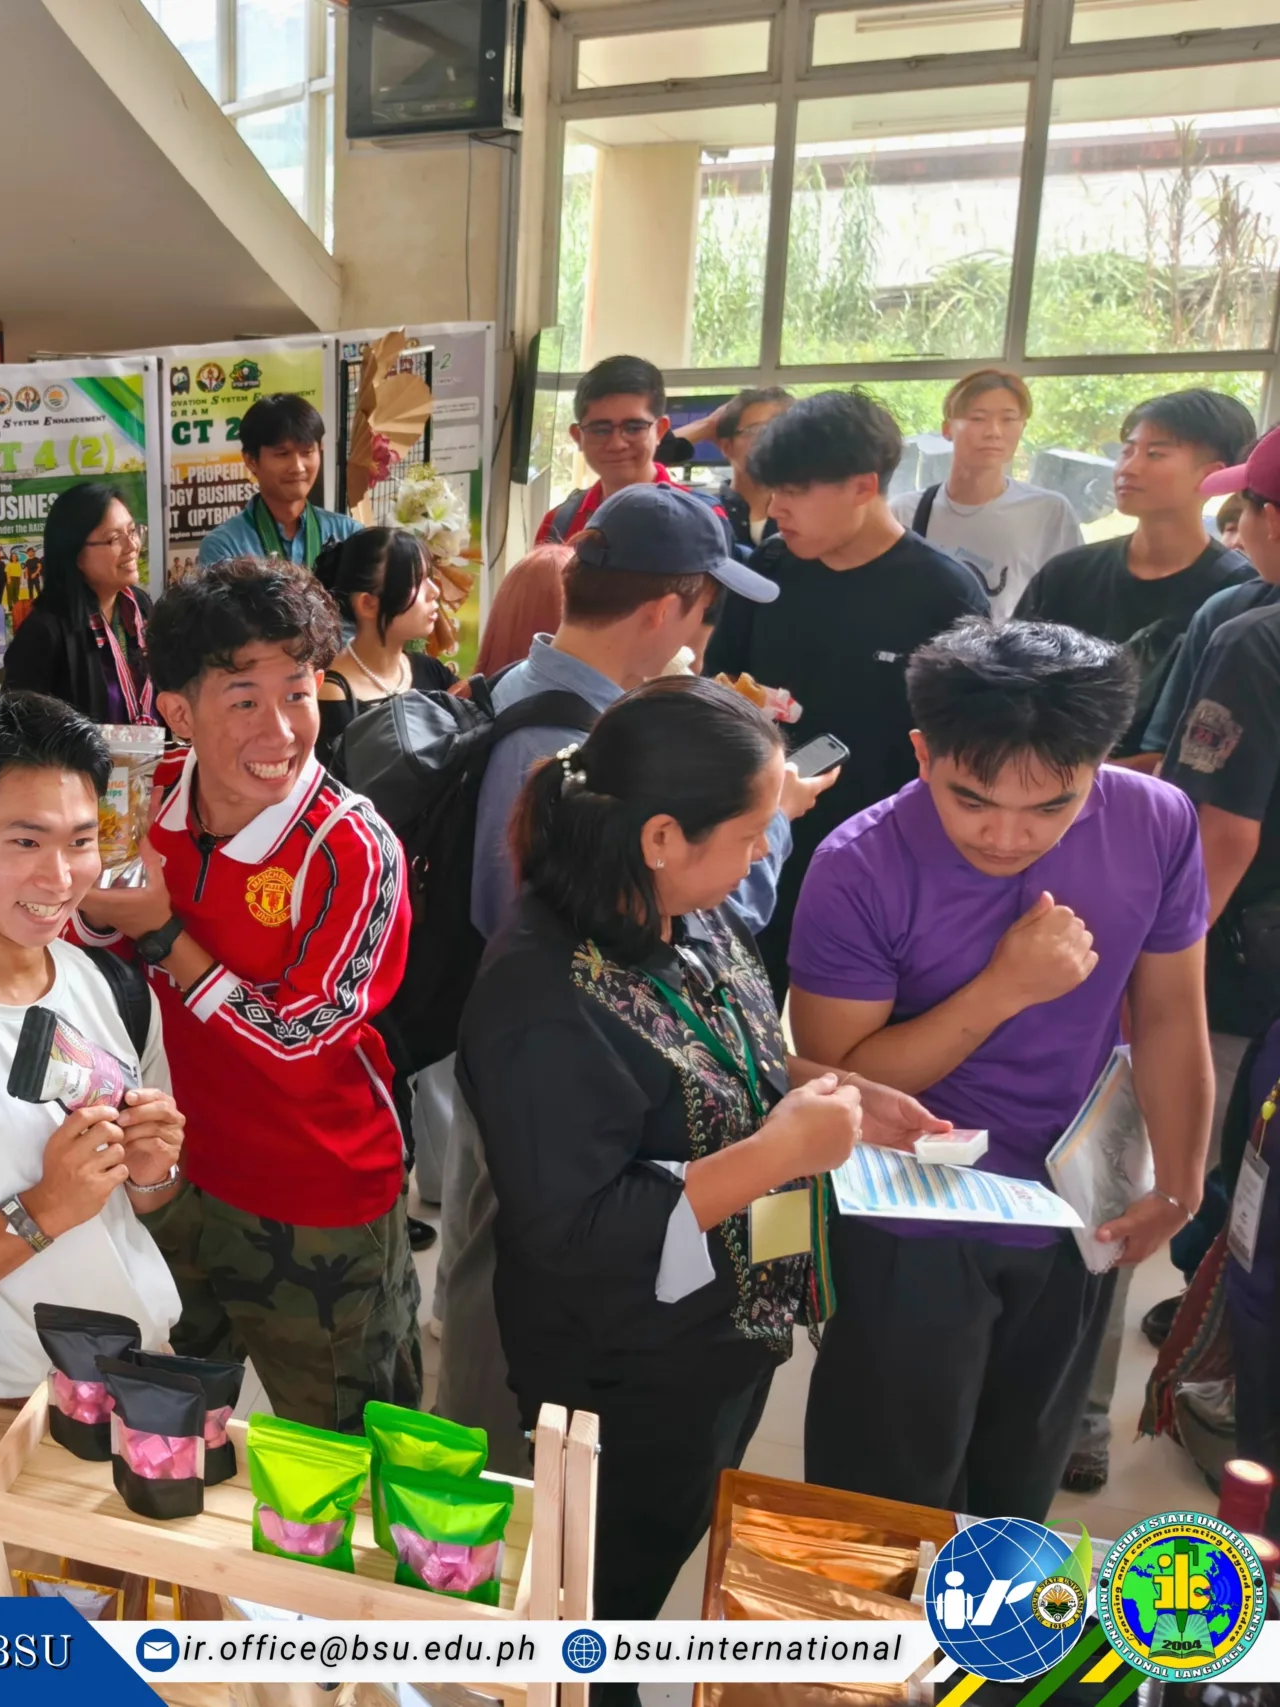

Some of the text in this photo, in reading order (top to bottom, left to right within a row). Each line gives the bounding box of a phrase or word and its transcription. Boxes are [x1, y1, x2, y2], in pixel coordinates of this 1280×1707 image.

[211, 396, 248, 405] SYSTEM
[2, 418, 39, 429] SYSTEM
[43, 415, 107, 427] ENHANCEMENT
[33, 439, 59, 471] 4
[68, 432, 115, 475] (2)
[1, 484, 13, 493] the
[198, 483, 260, 505] BUSINESS
[16, 525, 28, 534] the
[29, 522, 46, 533] RAIS
[256, 910, 287, 922] UNITED
